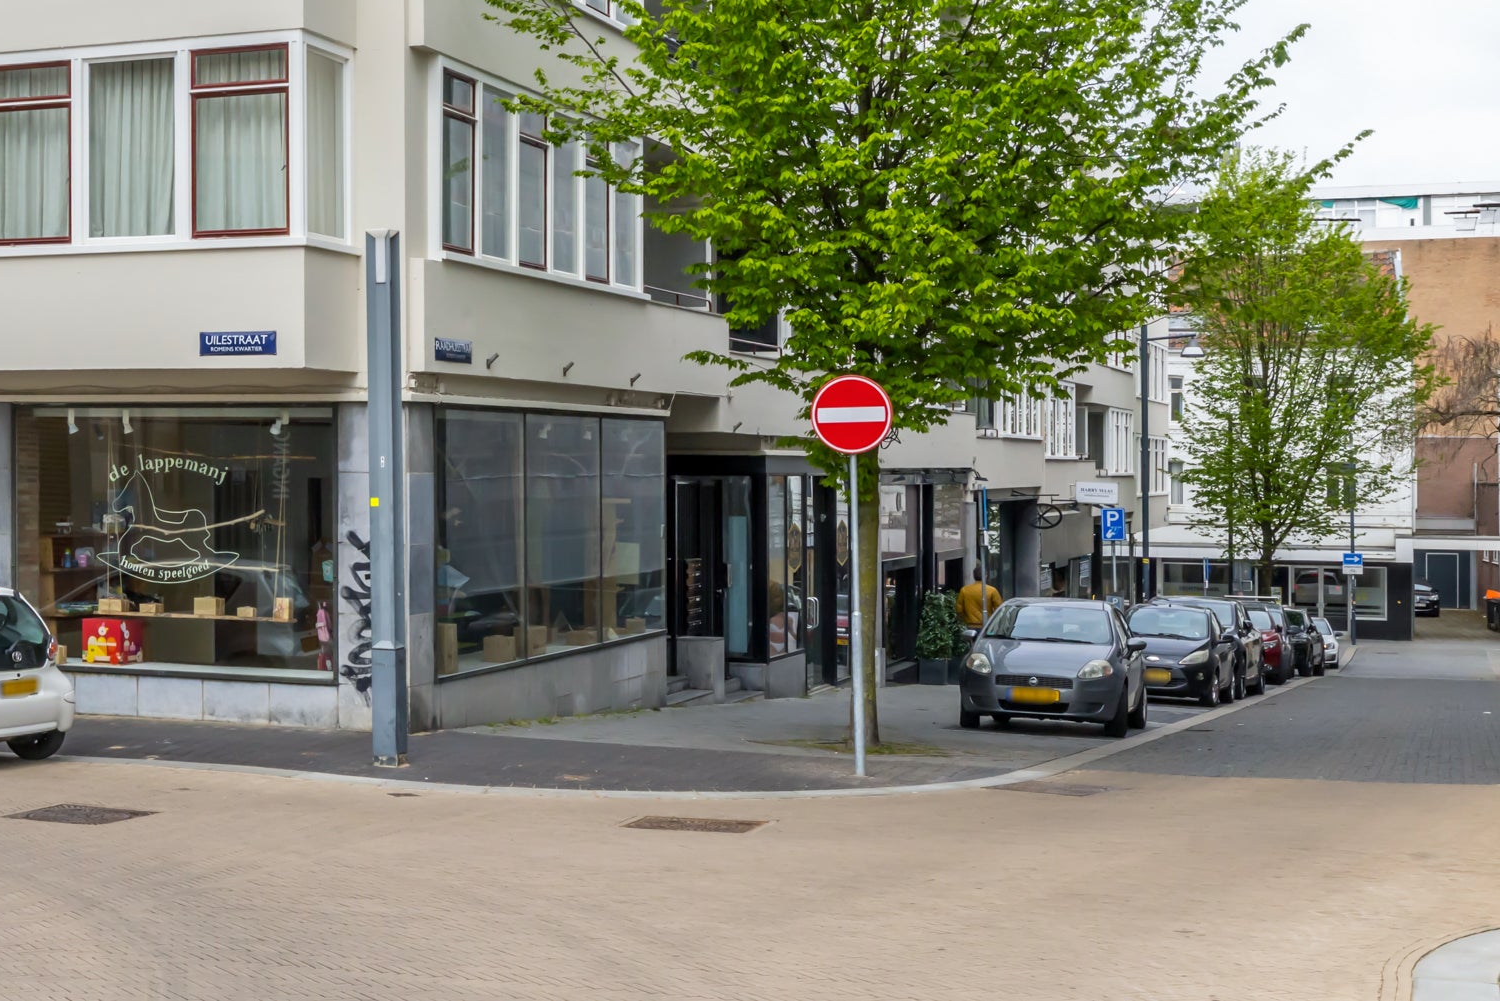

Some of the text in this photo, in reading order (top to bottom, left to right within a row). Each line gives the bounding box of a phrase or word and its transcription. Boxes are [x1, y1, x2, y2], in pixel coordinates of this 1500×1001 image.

[205, 334, 268, 346] UILESTRAAT
[109, 454, 229, 485] de lappemanj
[1106, 510, 1120, 527] P
[120, 555, 211, 580] houten speelgoed
